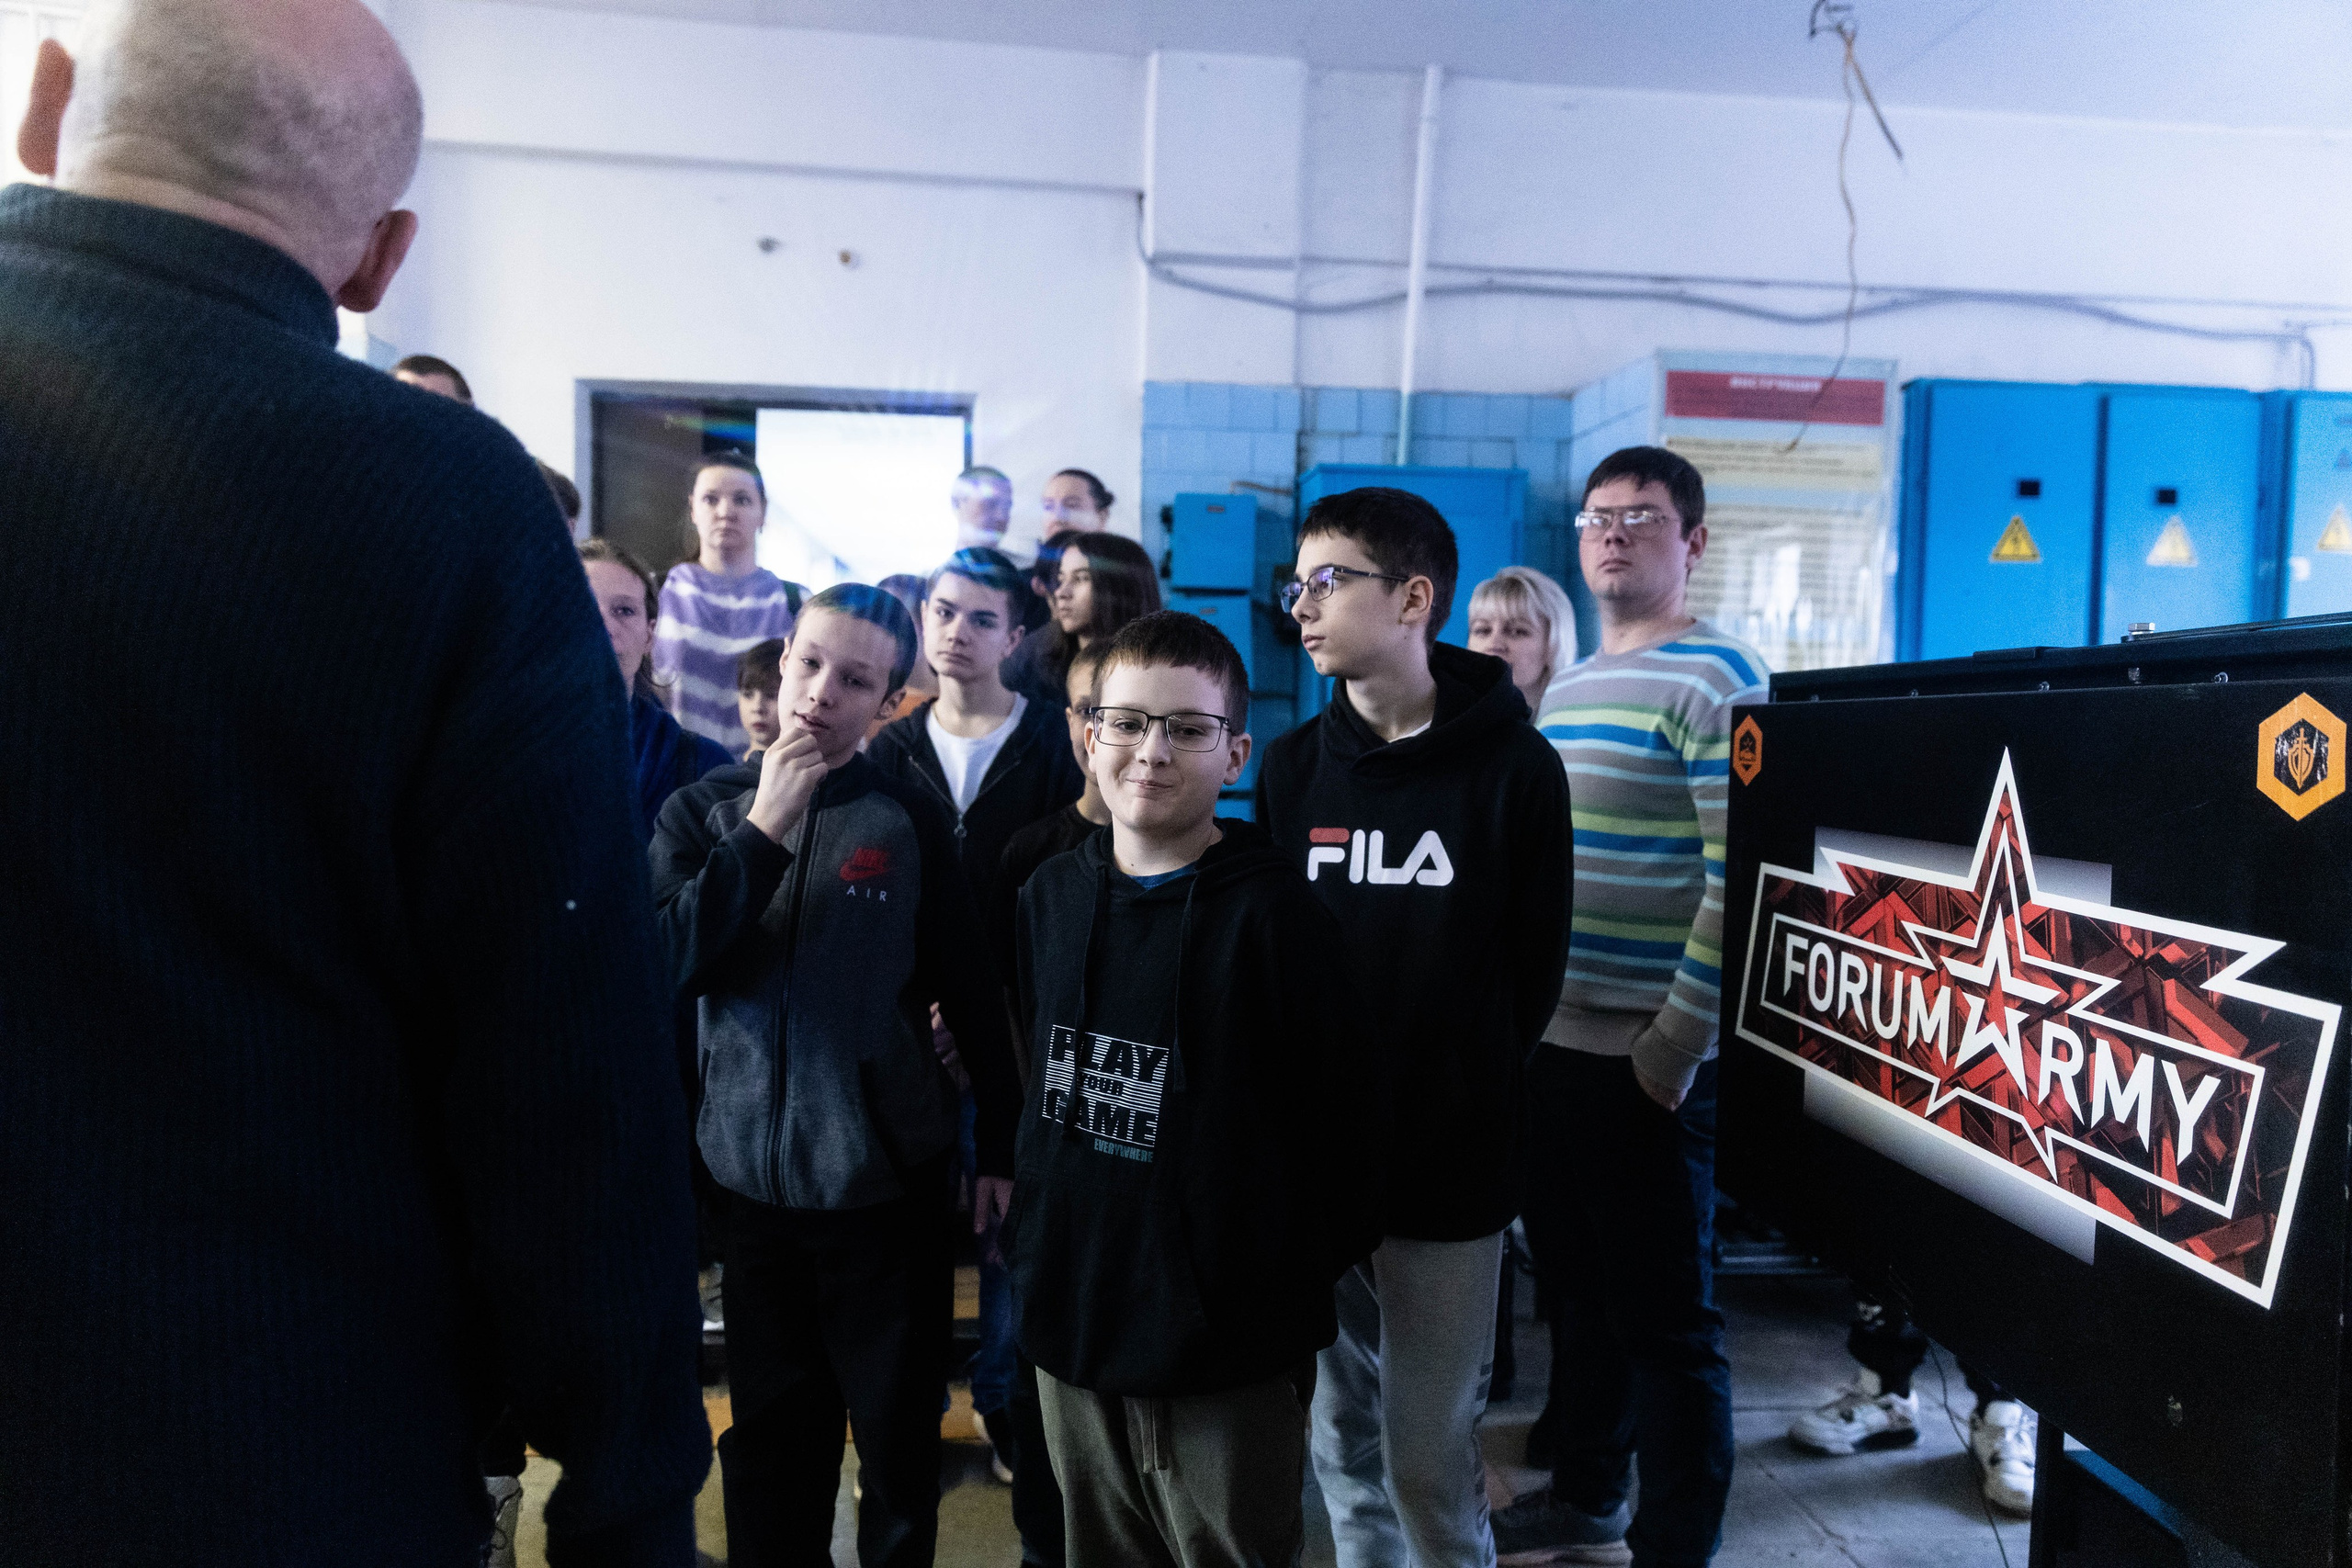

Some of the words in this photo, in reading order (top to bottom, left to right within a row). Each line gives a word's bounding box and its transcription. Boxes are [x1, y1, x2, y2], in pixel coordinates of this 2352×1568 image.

[1307, 828, 1454, 886] FILA
[846, 884, 888, 902] AIR
[1782, 931, 1954, 1066] FORUM
[1050, 1026, 1169, 1083] PLAY
[1044, 1088, 1157, 1145] GAME
[1093, 1138, 1154, 1163] EVERYWHERE
